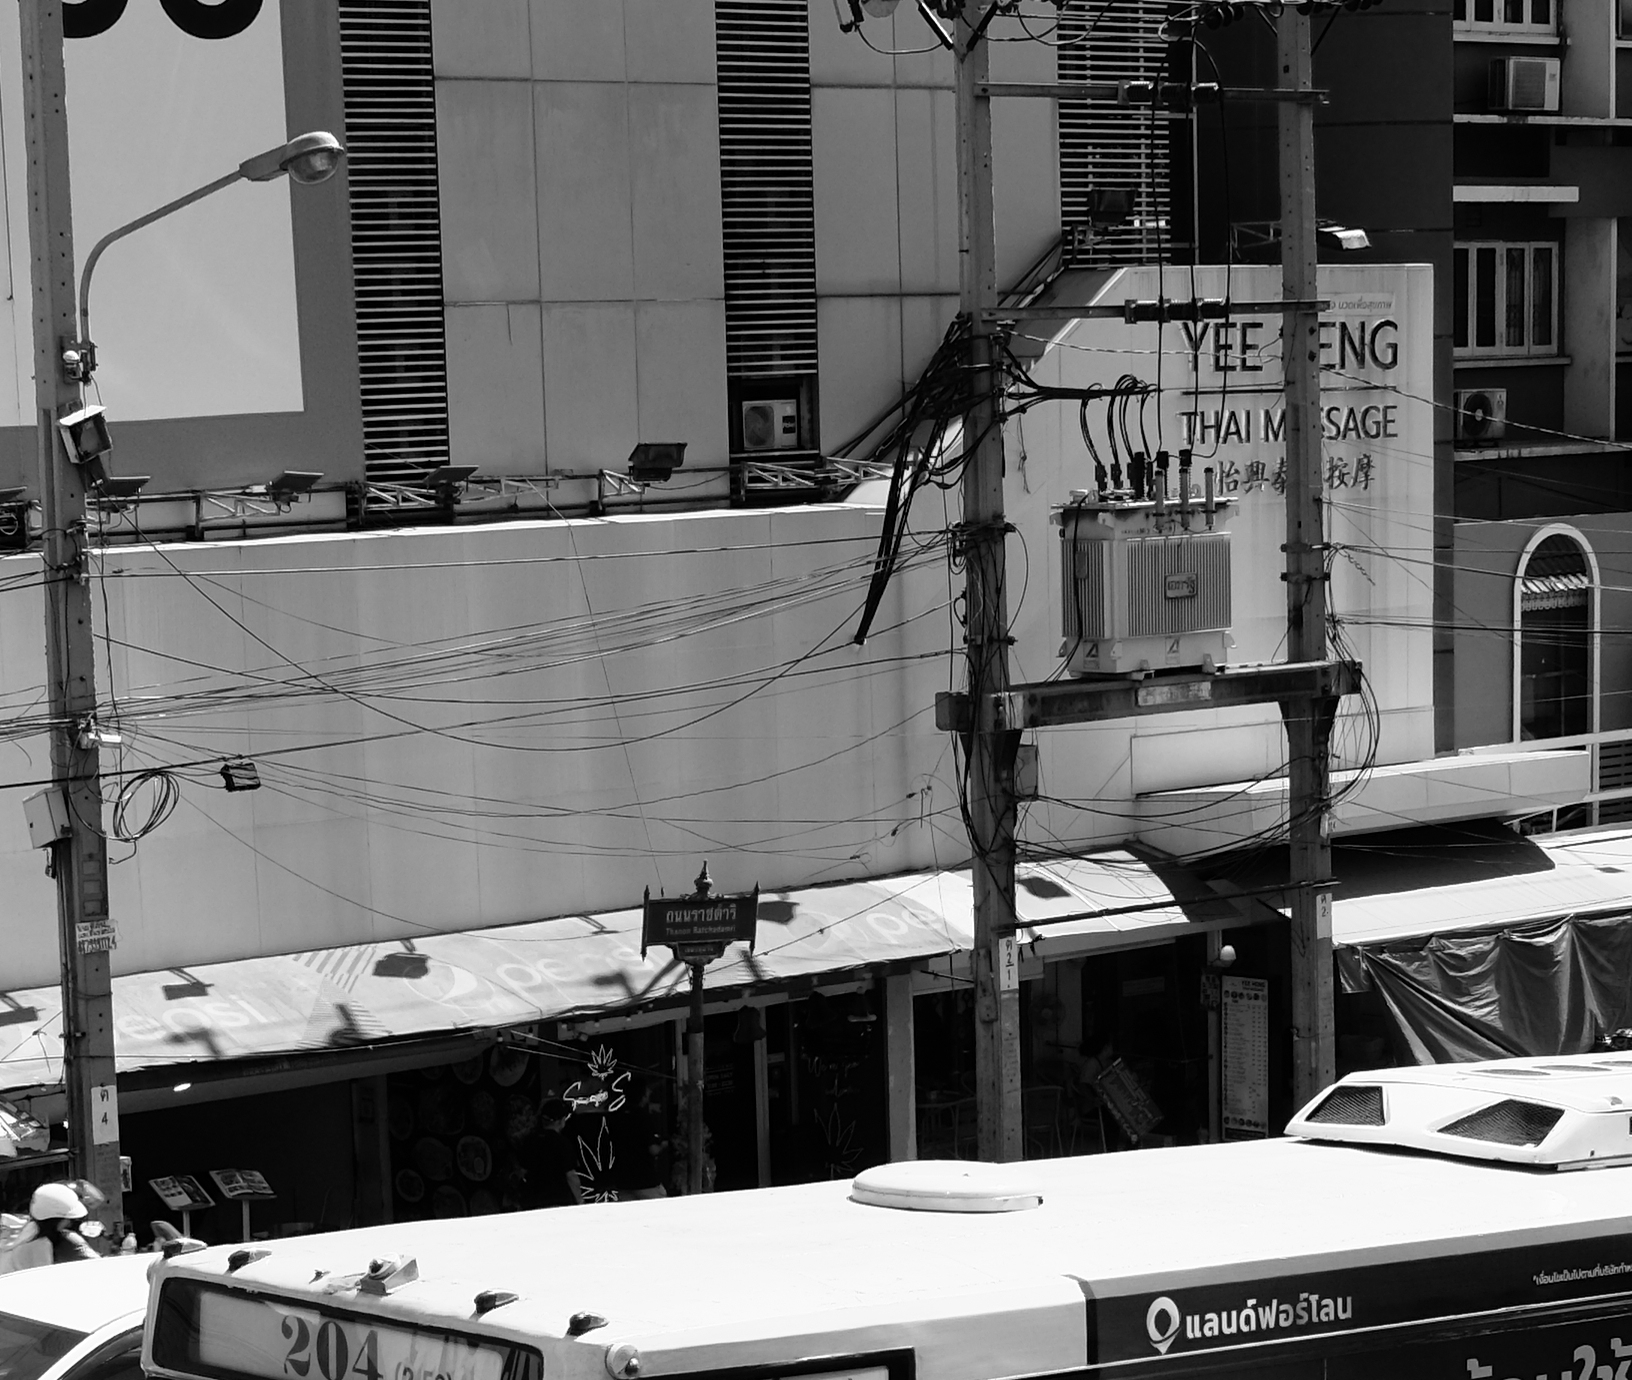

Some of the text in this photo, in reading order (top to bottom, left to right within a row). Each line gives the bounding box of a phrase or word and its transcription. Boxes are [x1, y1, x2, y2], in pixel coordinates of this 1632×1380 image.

[1181, 321, 1263, 372] YEE
[1178, 405, 1398, 444] THAI MSAGE
[666, 903, 737, 924] ถนนราชดำริ
[666, 927, 691, 936] Thanon
[101, 1112, 109, 1125] 4
[1185, 1292, 1353, 1340] แลนด์ฟอร์โลน
